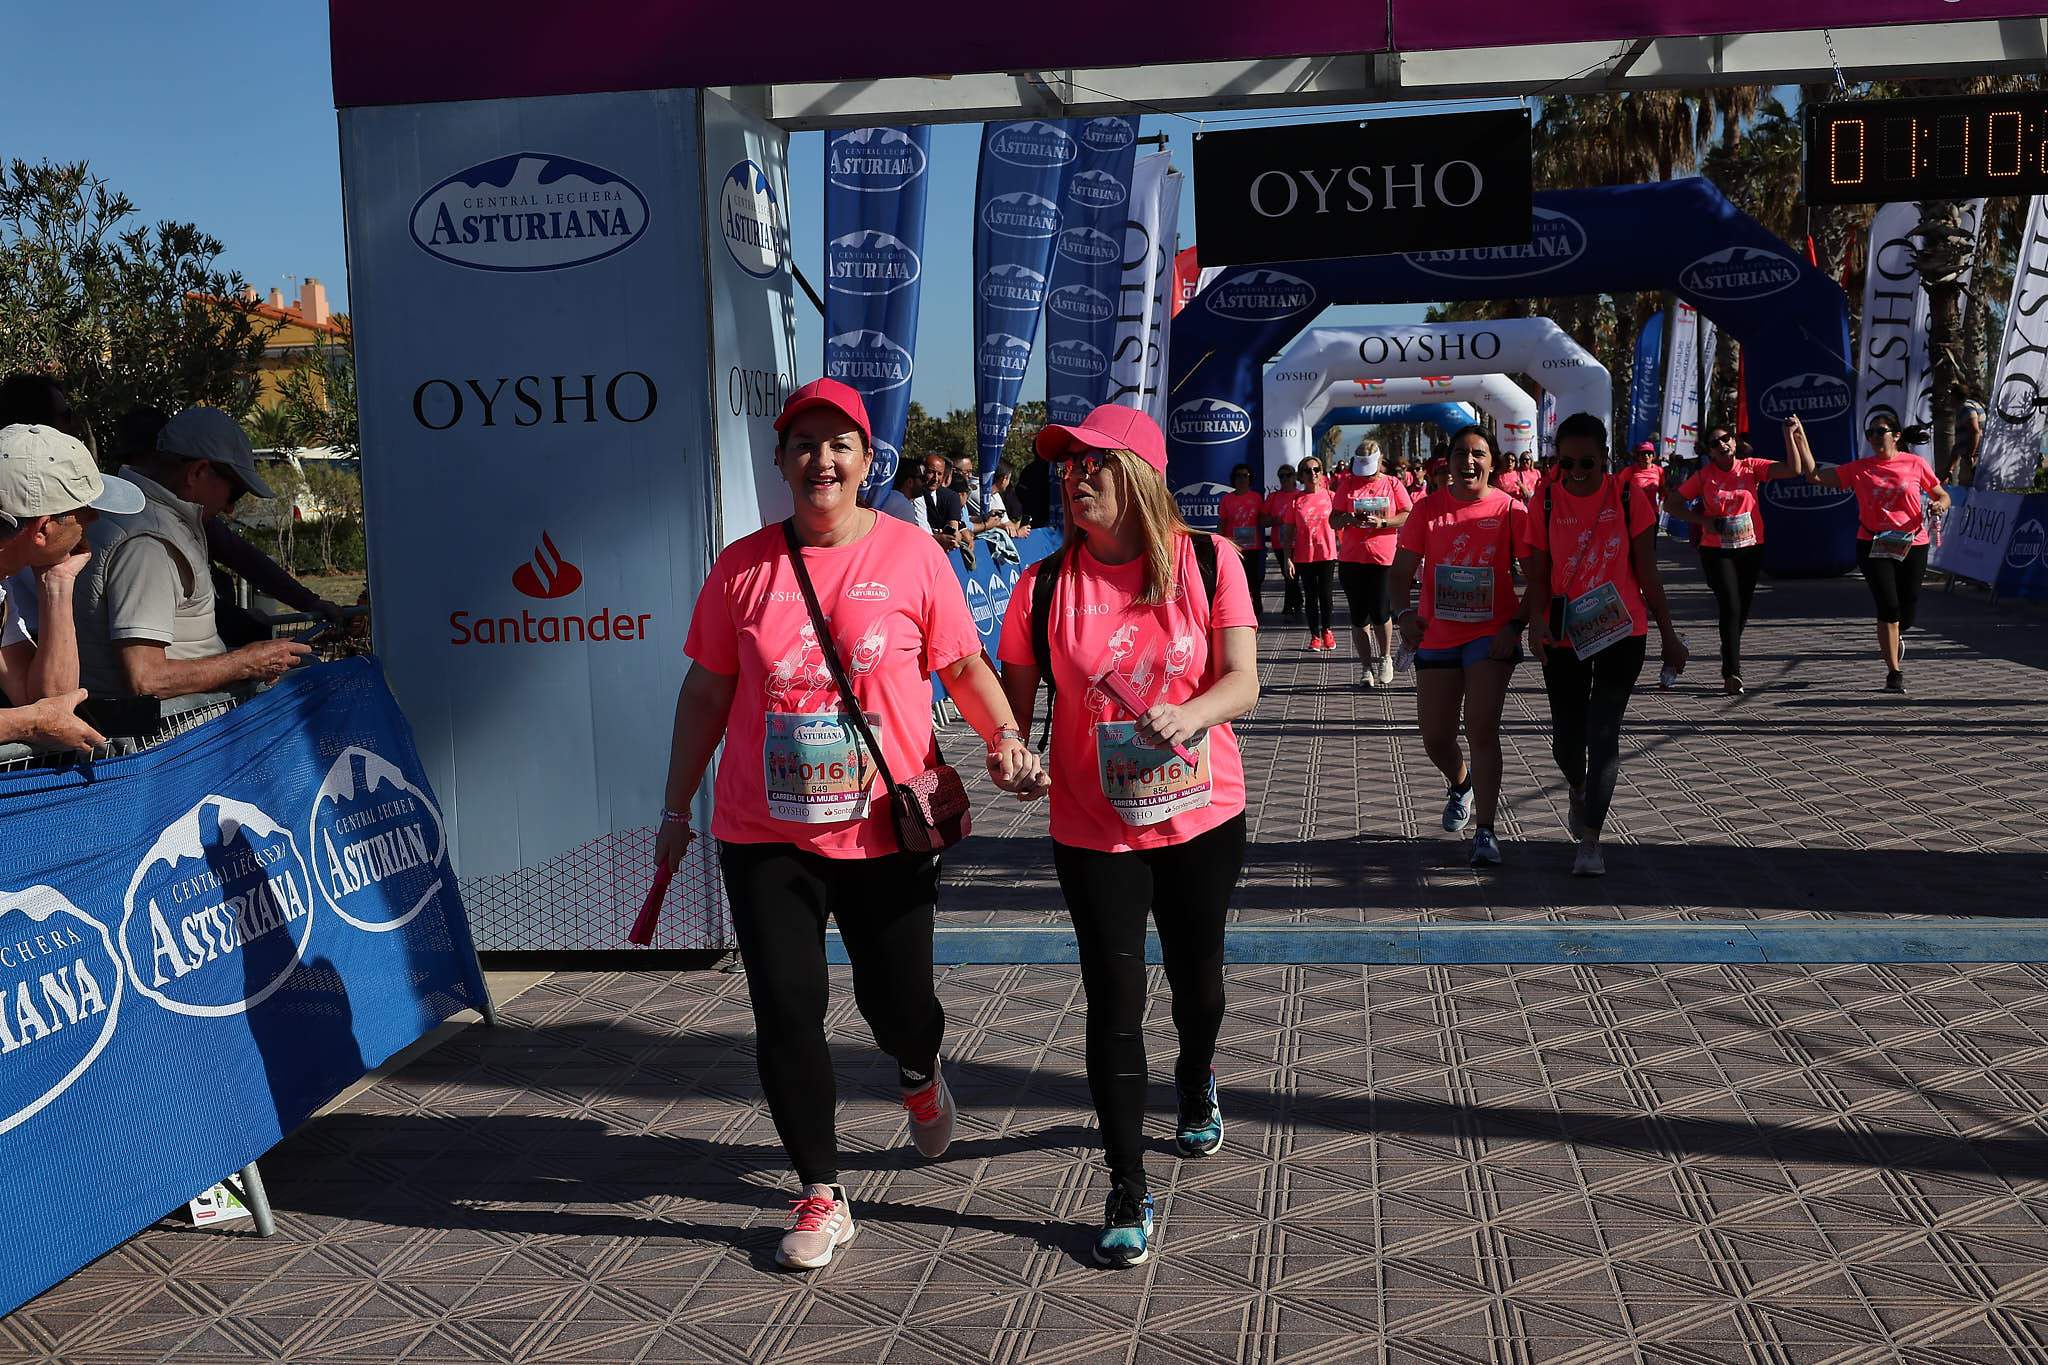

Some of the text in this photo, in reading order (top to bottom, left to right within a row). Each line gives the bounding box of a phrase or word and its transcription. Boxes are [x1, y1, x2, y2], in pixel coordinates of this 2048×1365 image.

[995, 135, 1070, 160] ASTURIANA
[463, 191, 623, 209] CENTRAL LECHERA
[1249, 160, 1483, 217] OYSHO
[429, 201, 632, 246] ASTURIANA
[726, 195, 782, 255] ASTURIANA
[1689, 268, 1794, 290] ASTURIANA
[1053, 294, 1110, 317] ASTURIANA
[1212, 290, 1307, 309] ASTURIANA
[1359, 331, 1501, 365] OYSHO
[1542, 358, 1585, 369] OYSHO
[1275, 371, 1319, 382] OYSHO
[412, 370, 658, 430] OYSHO
[729, 366, 791, 418] OYSHO
[1766, 393, 1848, 414] ASTURIANA
[1172, 416, 1246, 434] ASTURIANA
[449, 607, 651, 645] Santander
[796, 729, 843, 740] ASTURIANA
[772, 792, 797, 801] CARRERA
[806, 795, 815, 803] LA
[816, 794, 839, 803] MUJER
[811, 785, 828, 793] 849
[1153, 785, 1168, 795] 854
[1158, 794, 1177, 803] MUJER
[1181, 785, 1206, 797] VALENCIA
[336, 808, 377, 835] CENTRAL
[778, 805, 810, 817] OYSHO
[324, 823, 433, 900] ASTURIAN
[173, 866, 231, 904] CENTRAL
[149, 870, 307, 988] ASTURIANA
[0, 926, 82, 968] CHERA
